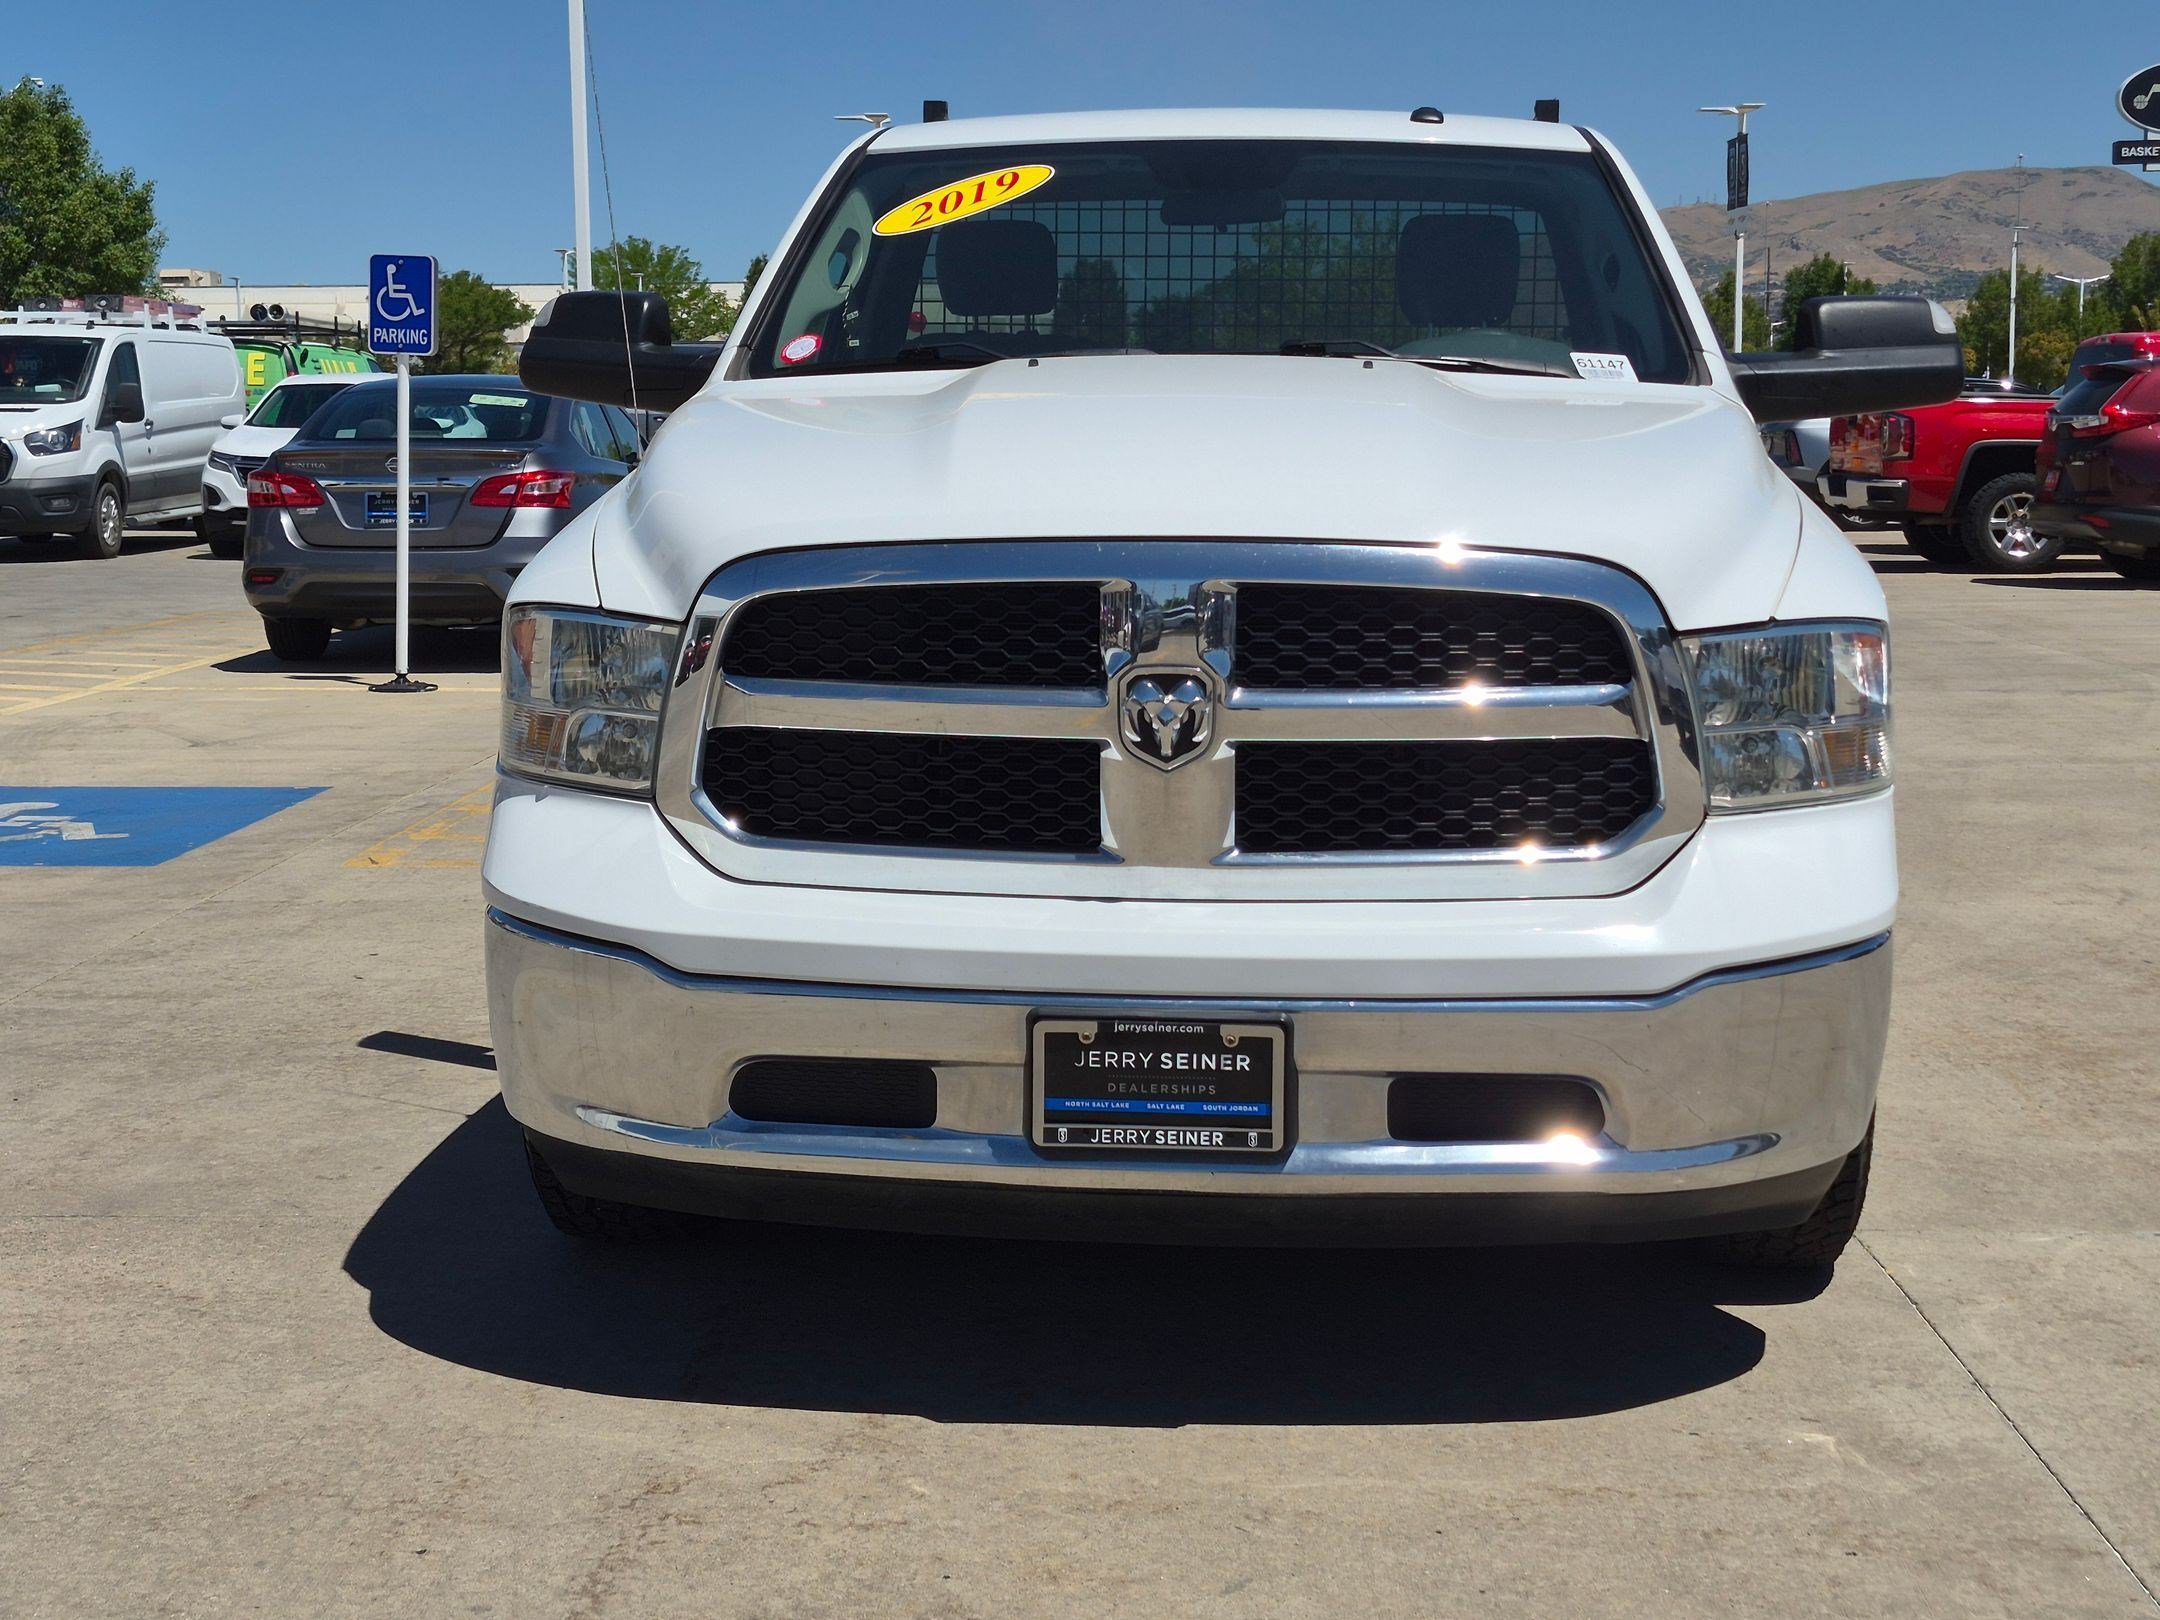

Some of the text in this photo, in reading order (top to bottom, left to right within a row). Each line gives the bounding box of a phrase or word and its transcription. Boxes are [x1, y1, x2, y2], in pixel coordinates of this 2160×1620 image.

[2121, 146, 2160, 157] BASKE
[910, 171, 1020, 227] 2019
[373, 327, 428, 345] PARKING
[1576, 358, 1624, 371] 61147
[1113, 1021, 1204, 1034] jerryseiner.com
[1074, 1050, 1251, 1072] JERRY SEINER
[1107, 1082, 1217, 1095] DEALERSHIPS
[1065, 1100, 1130, 1109] NORTH SALT LAKE
[1147, 1102, 1185, 1111] SALT LAKE
[1202, 1104, 1259, 1113] SOUTH JORDAN
[1091, 1128, 1224, 1146] JERRY SEINER
